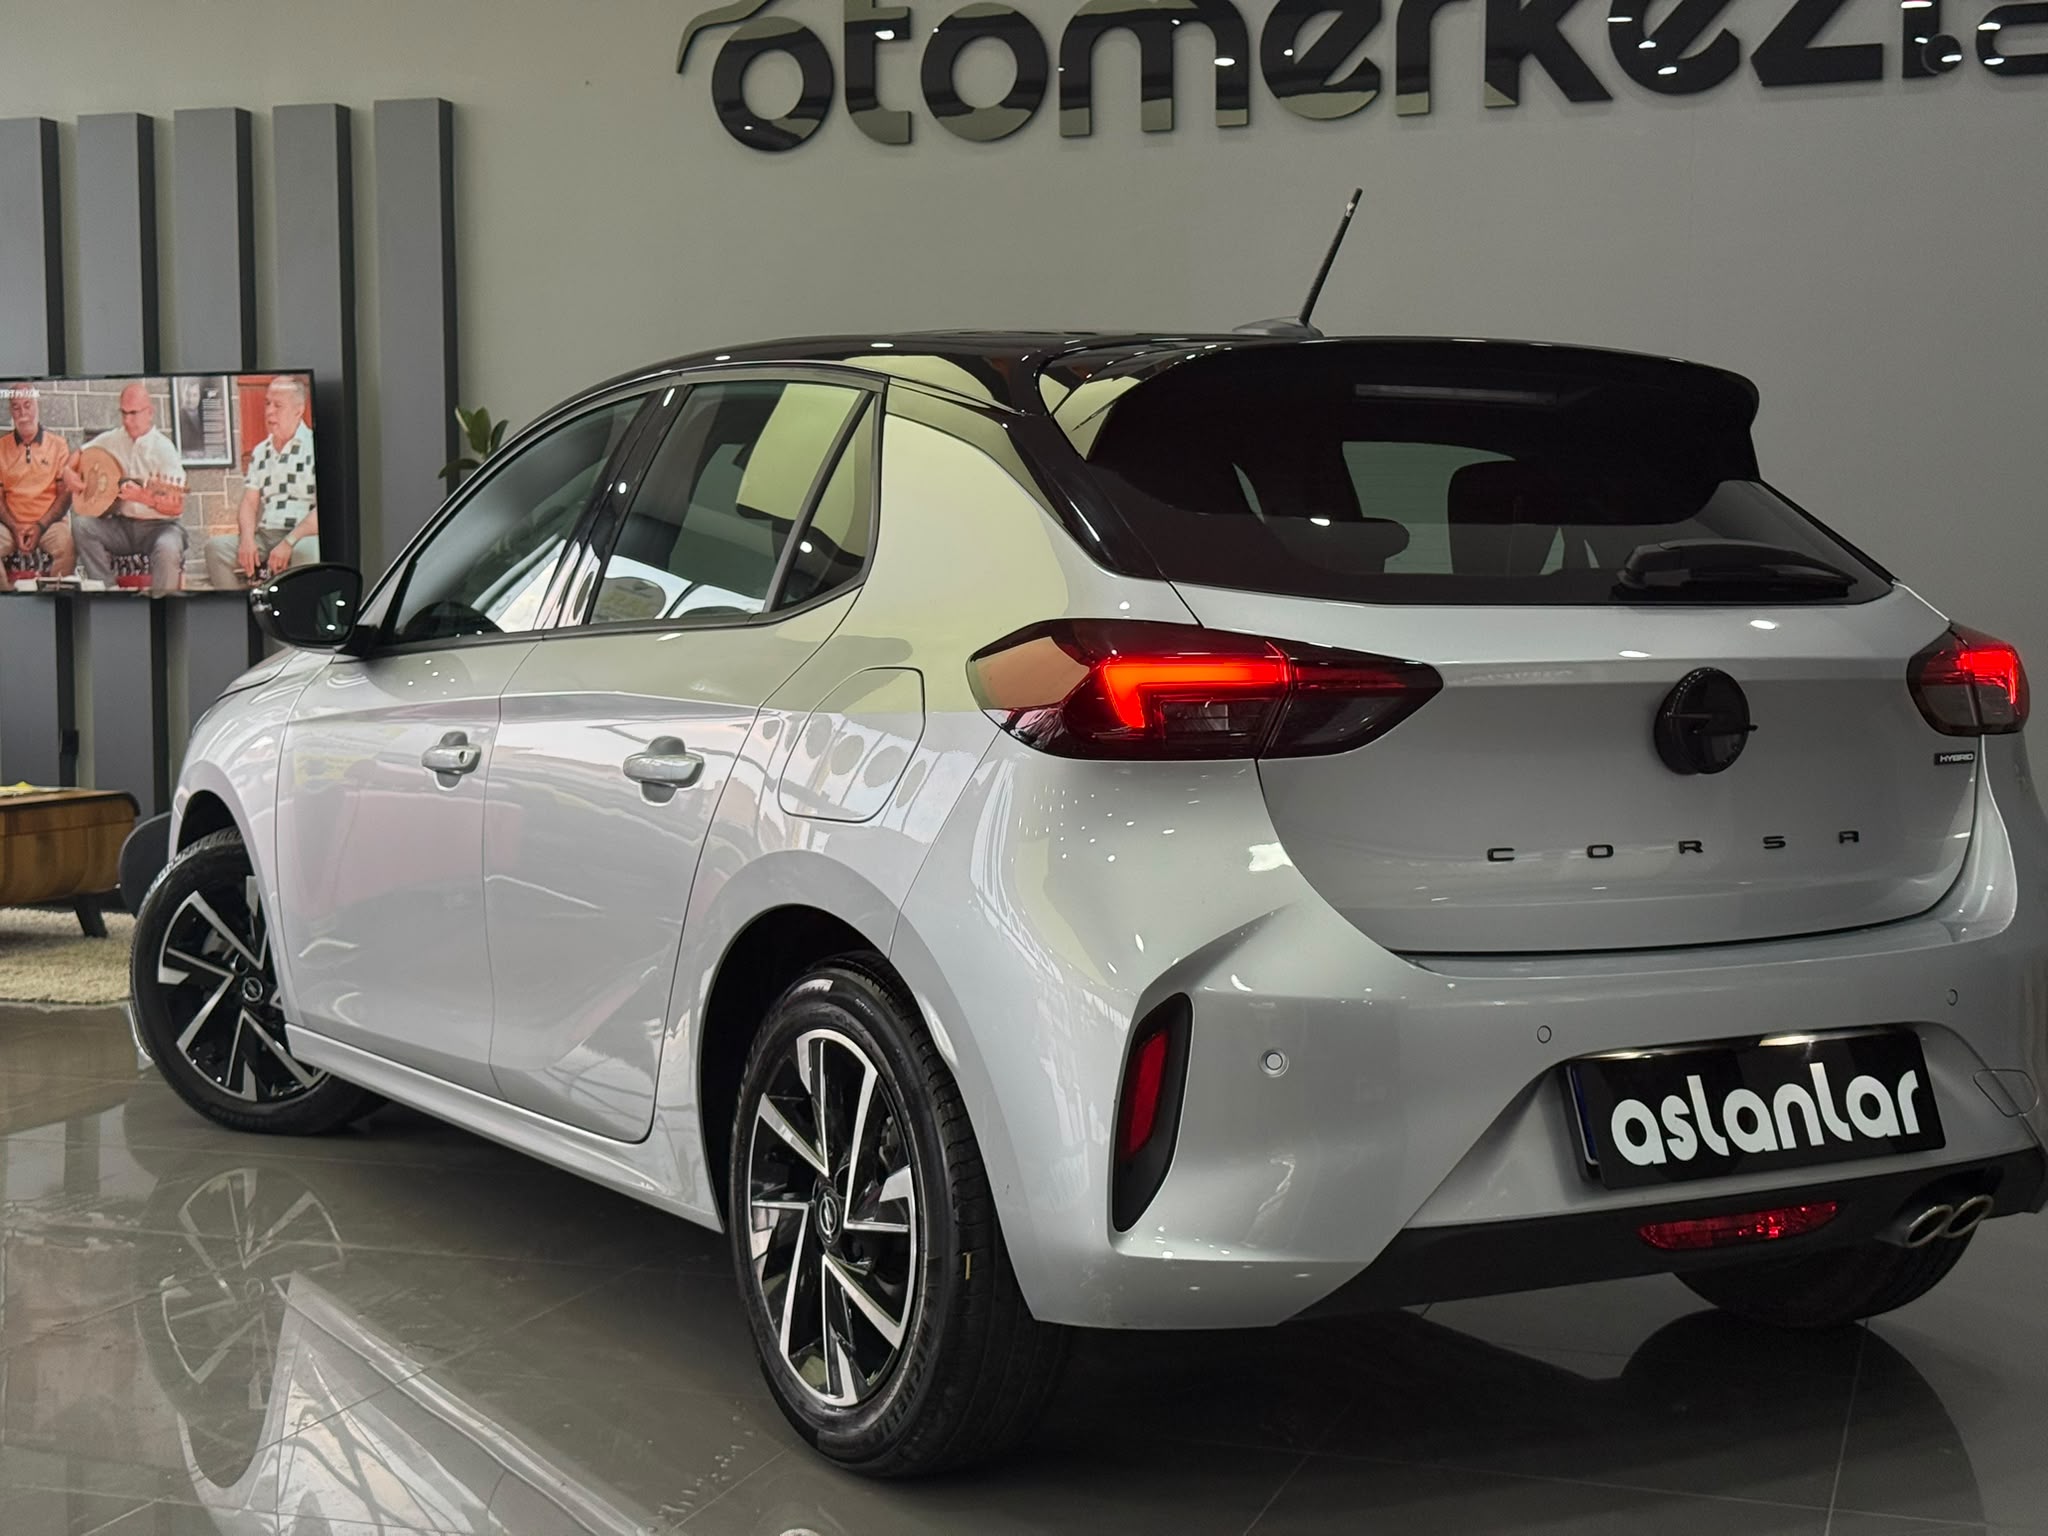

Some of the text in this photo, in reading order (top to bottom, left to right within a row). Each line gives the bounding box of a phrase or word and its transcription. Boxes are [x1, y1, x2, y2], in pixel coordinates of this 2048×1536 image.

[1939, 753, 1974, 763] HYBRID
[1487, 830, 1860, 863] CORSA
[1611, 1062, 1921, 1166] aslanlar
